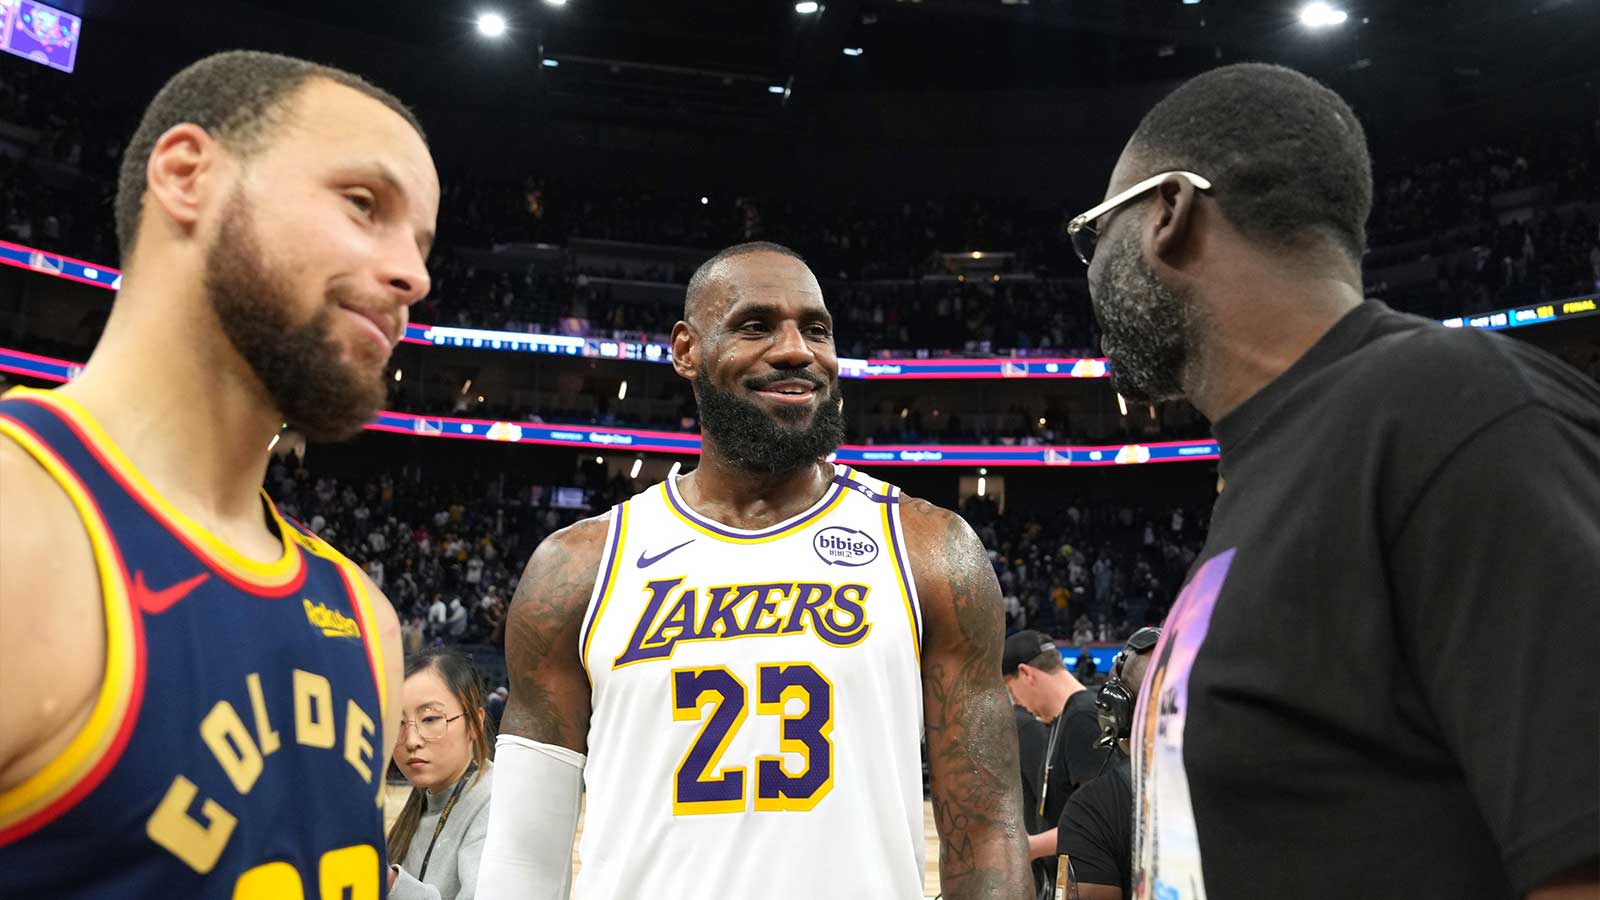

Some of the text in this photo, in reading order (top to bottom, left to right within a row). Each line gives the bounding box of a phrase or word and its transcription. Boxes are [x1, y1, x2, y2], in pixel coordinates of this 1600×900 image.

[819, 535, 875, 556] bibigo
[611, 575, 873, 671] LAKERS
[146, 668, 385, 875] GOLDE
[671, 661, 835, 817] 23
